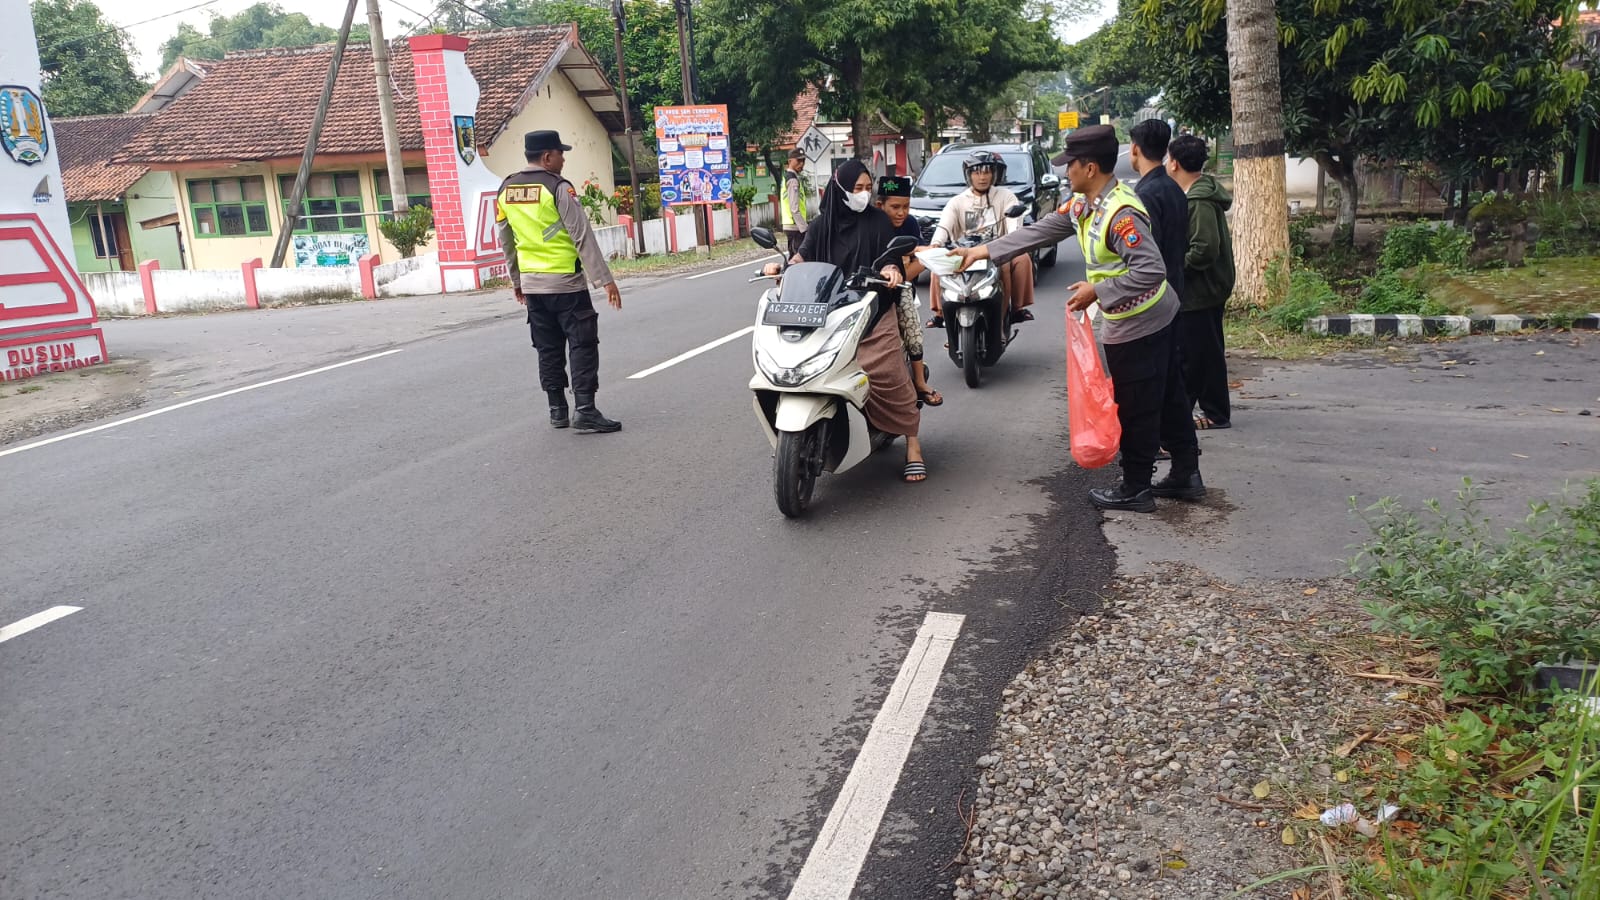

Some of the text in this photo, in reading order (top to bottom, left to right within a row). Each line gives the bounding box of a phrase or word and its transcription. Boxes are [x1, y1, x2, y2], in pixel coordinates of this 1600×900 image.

[507, 188, 540, 201] POLISI
[490, 265, 507, 277] DESA
[782, 304, 807, 314] 2543
[808, 305, 826, 314] ECF
[7, 342, 76, 367] DUSUN
